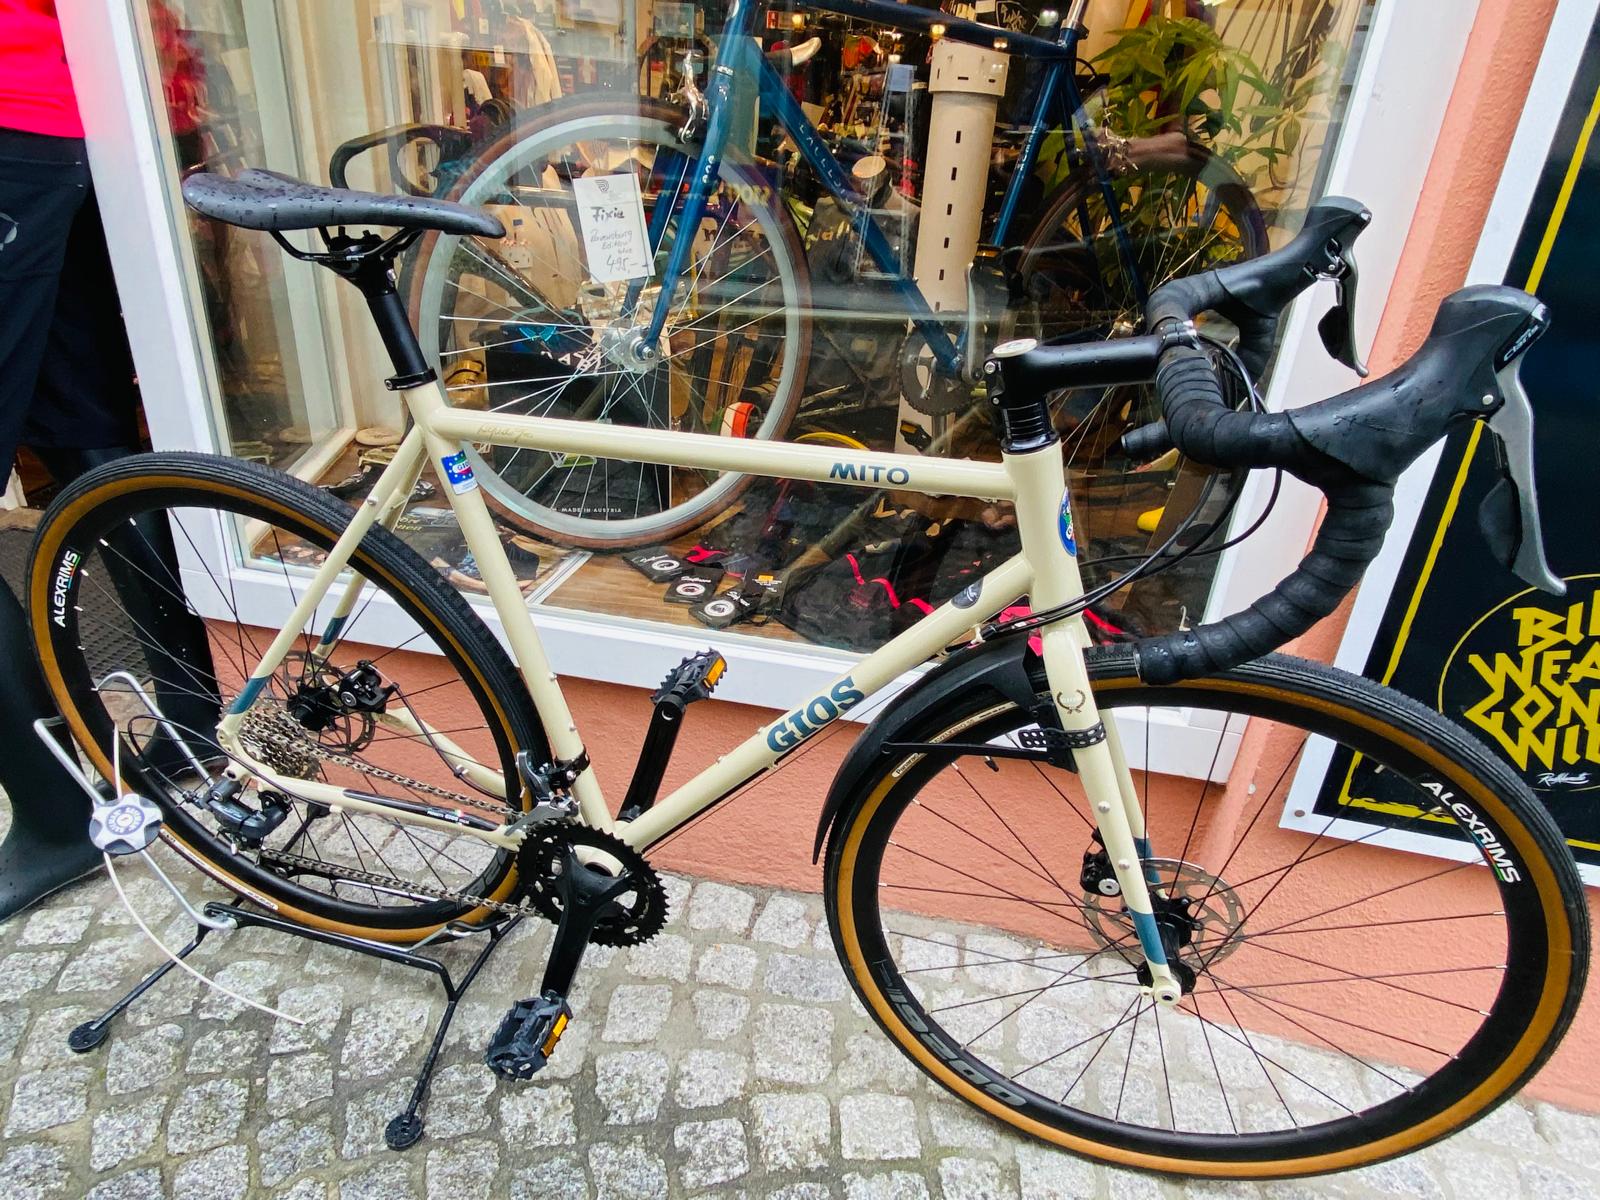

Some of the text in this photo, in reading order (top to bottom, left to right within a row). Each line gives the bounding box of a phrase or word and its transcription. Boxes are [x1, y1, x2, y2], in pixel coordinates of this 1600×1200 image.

[590, 206, 625, 221] Fixie
[829, 462, 910, 485] MITO
[54, 550, 78, 628] ALEXRIMS
[766, 675, 865, 752] GIOS
[1420, 782, 1521, 884] ALEXRIMS
